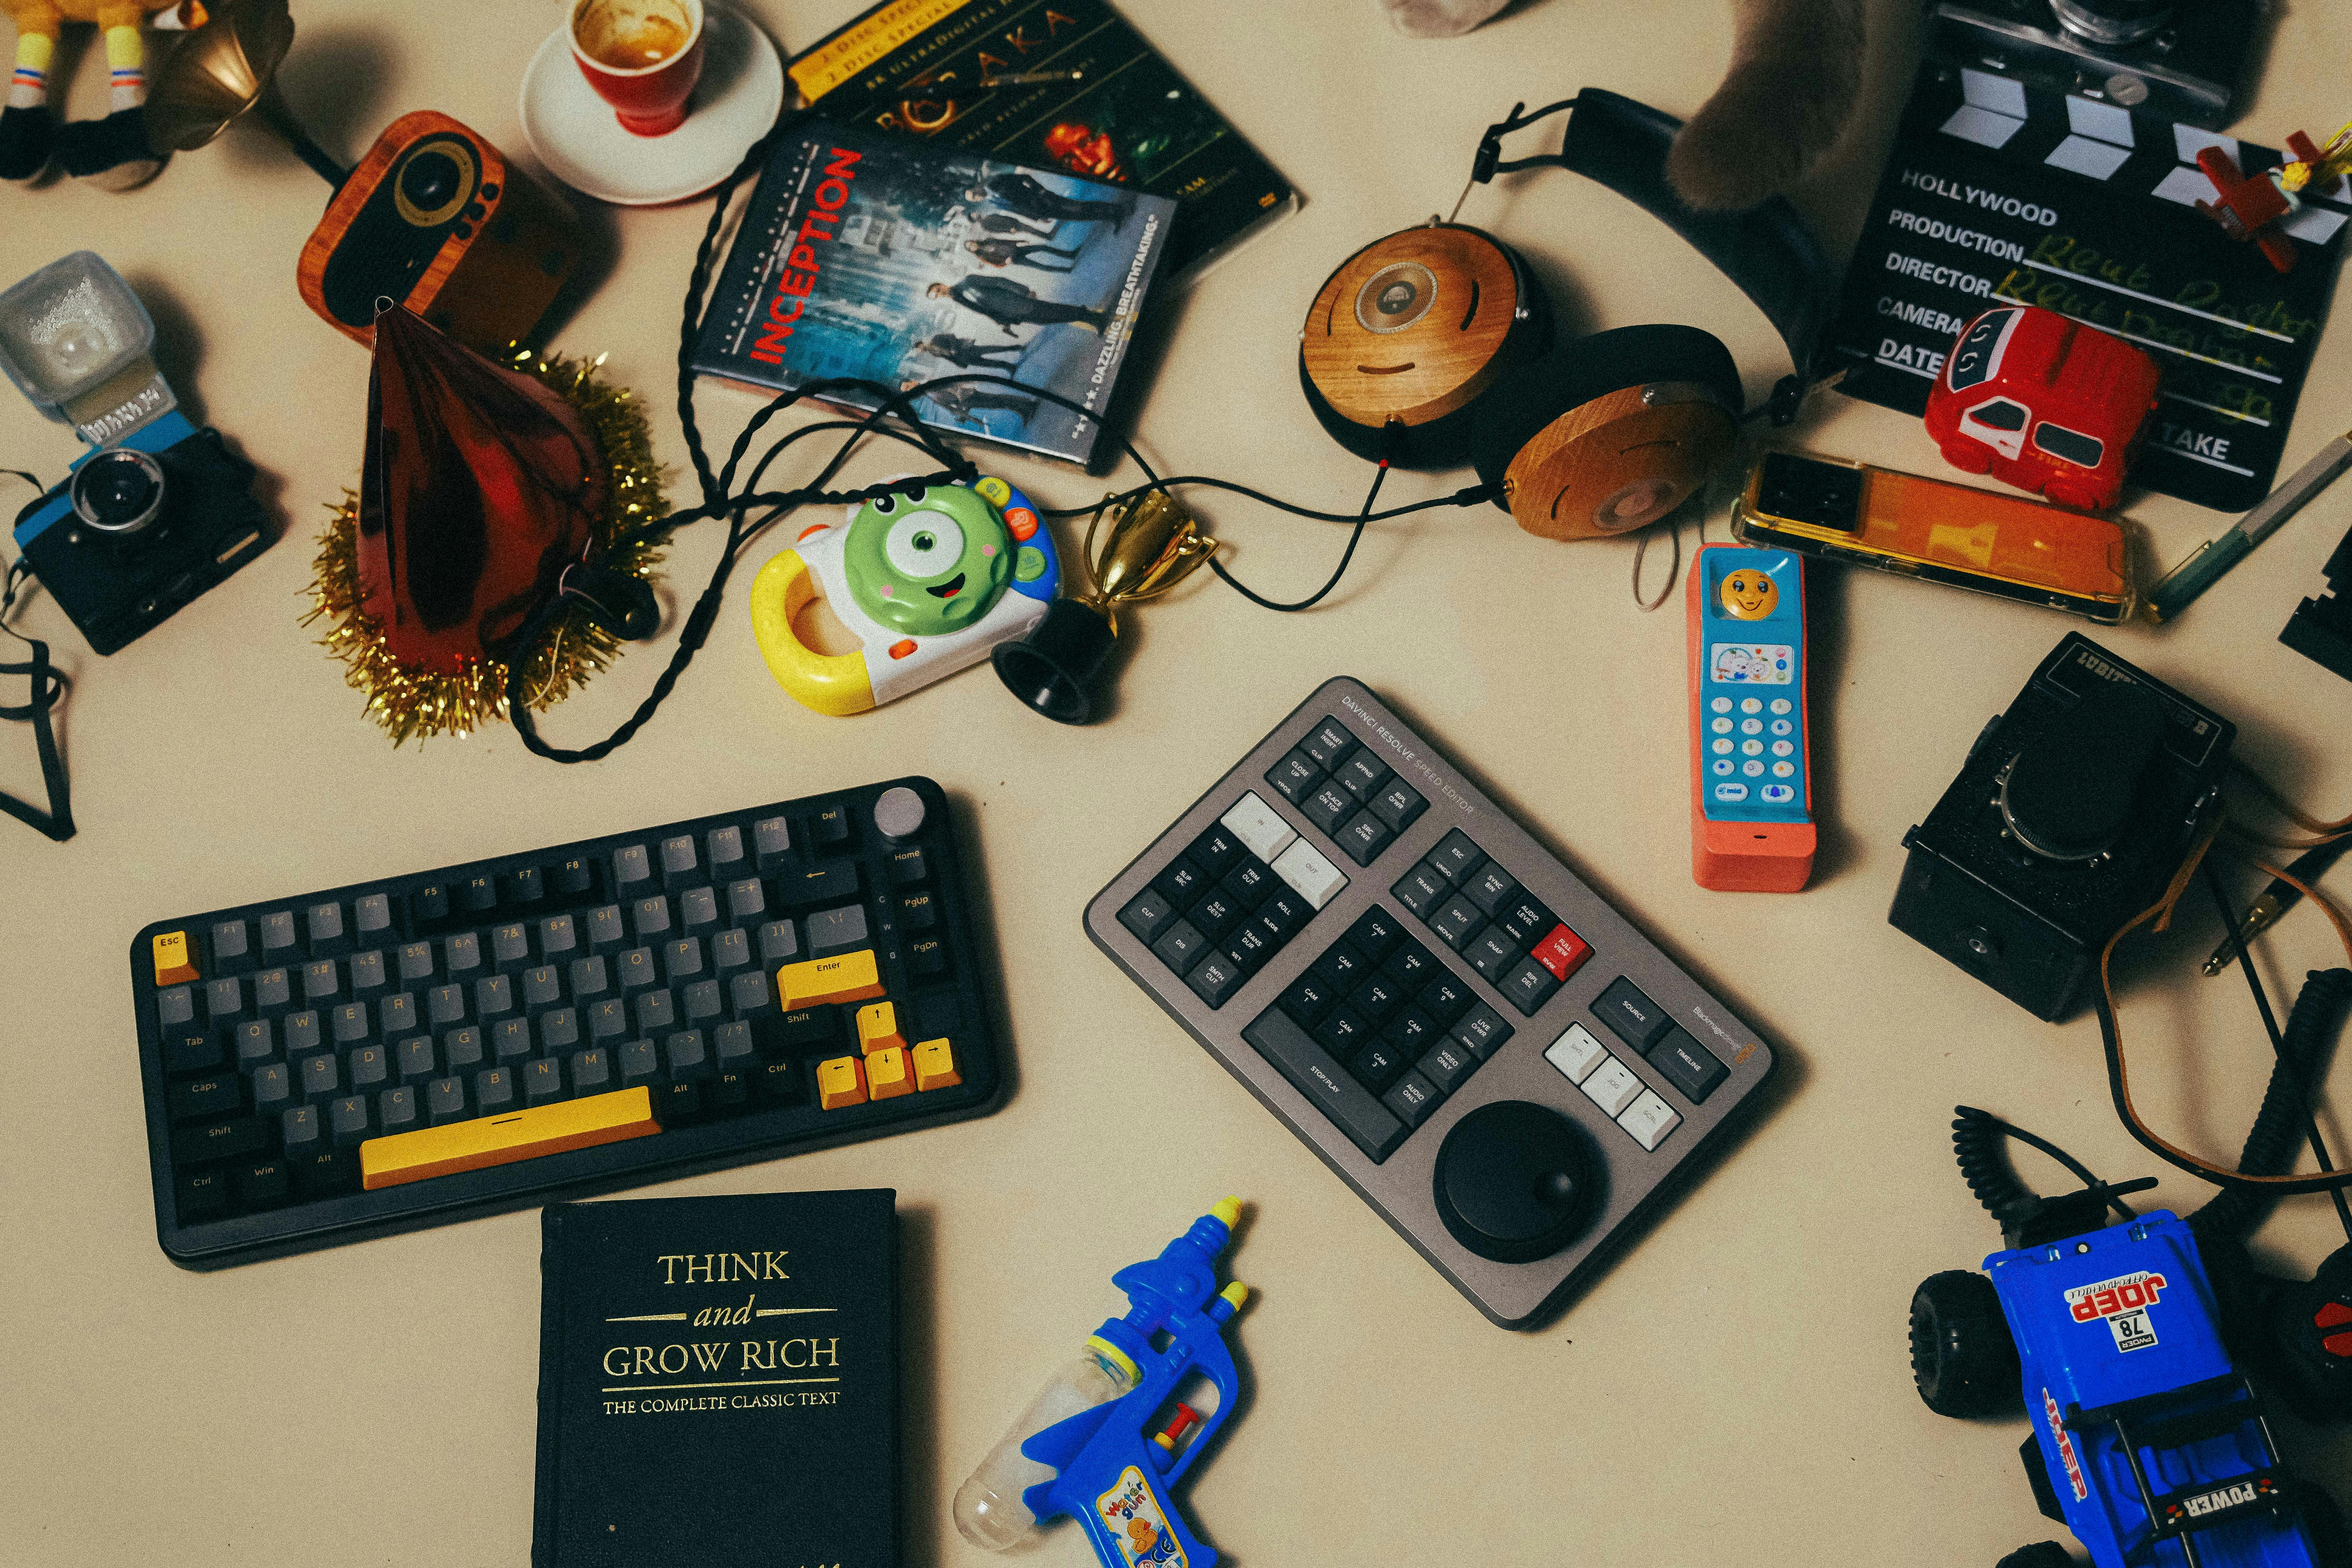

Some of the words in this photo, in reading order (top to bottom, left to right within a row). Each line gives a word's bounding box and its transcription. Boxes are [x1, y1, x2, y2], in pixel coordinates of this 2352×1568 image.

[1901, 168, 2058, 227] HOLLYWOOD
[1888, 210, 2024, 262] PRODUCTION
[750, 148, 862, 364] INCEPTION
[1885, 253, 1993, 298] DIRECTOR
[1876, 298, 1963, 336] CAMERA
[1878, 339, 1945, 374] DATE
[2161, 423, 2230, 460] TAKE
[2077, 651, 2138, 683] LUBIT
[1320, 735, 1337, 748] INSRT
[1325, 729, 1342, 745] SMART
[1312, 750, 1323, 760] CLIP
[1342, 696, 1378, 728] DAVINCI
[1377, 726, 1415, 762] RESOLVE
[1415, 760, 1442, 786] SPEED
[1442, 784, 1474, 815] EDITOR
[1291, 761, 1308, 777] CLOSE
[1355, 762, 1374, 778] APPND
[1278, 781, 1291, 794] YPOS
[1345, 781, 1356, 791] CLIP
[1325, 791, 1342, 807] PLACE
[1389, 795, 1404, 809] O/WR
[1394, 792, 1406, 804] RIPL
[1329, 802, 1339, 812] TOP
[822, 811, 836, 820] Del
[1355, 827, 1370, 841] O/WR
[1362, 824, 1374, 835] SRC
[1214, 838, 1227, 851] TRIM
[895, 850, 920, 861] Home
[1452, 848, 1464, 859] ESC
[566, 861, 579, 870] F8
[1436, 862, 1451, 877] UNDO
[519, 870, 531, 879] F7
[1175, 875, 1187, 886] SRC
[1180, 870, 1191, 881] SLIP
[1242, 874, 1254, 885] OUT
[1246, 868, 1259, 881] TRIM
[1416, 877, 1433, 894] TRANS
[1485, 882, 1495, 892] BIN
[1488, 875, 1503, 889] SYNC
[905, 897, 928, 907] PgUp
[1404, 894, 1417, 907] TITLE
[1142, 908, 1154, 918] CUT
[1207, 905, 1222, 918] DEST
[1213, 902, 1225, 913] SLIP
[1277, 902, 1291, 916] ROLL
[1521, 905, 1539, 921] AUDIO
[1452, 910, 1467, 923] SPLIT
[1517, 910, 1532, 926] LEVEL
[1264, 918, 1278, 932] SLIDE
[1372, 923, 1385, 936] CAM
[1437, 925, 1453, 940] MOVE
[1506, 924, 1522, 939] MARK
[160, 936, 179, 946] ESC
[1175, 939, 1185, 949] DIS
[1242, 937, 1254, 949] DUR
[1245, 930, 1262, 947] TRANS
[1559, 938, 1571, 951] FULL
[680, 944, 688, 954] P
[914, 941, 937, 952] PgDn
[1487, 941, 1502, 954] SNAP
[1231, 951, 1241, 961] SET
[1407, 955, 1420, 968] CAM
[816, 960, 841, 972] Enter
[1339, 956, 1352, 969] CAM
[537, 971, 545, 982] U
[1206, 973, 1218, 983] CUT
[1209, 966, 1224, 981] SMTH
[1526, 972, 1537, 983] RIPL
[489, 981, 499, 991] Y
[1521, 976, 1531, 988] DEL
[443, 990, 450, 1000] T
[1305, 989, 1318, 1001] CAM
[1373, 988, 1386, 1000] CAM
[1442, 987, 1455, 1000] CAM
[347, 1008, 355, 1019] E
[604, 1004, 612, 1014] K
[1623, 1001, 1645, 1022] SOURCE
[296, 1016, 309, 1027] W
[787, 1012, 810, 1023] Shift
[508, 1024, 517, 1034] H
[1340, 1021, 1352, 1033] CAM
[1408, 1020, 1421, 1032] CAM
[1472, 1023, 1487, 1037] O/WR
[1477, 1019, 1490, 1031] LIVE
[185, 1037, 203, 1046] Tab
[413, 1042, 420, 1052] F
[364, 1052, 373, 1062] D
[586, 1054, 596, 1064] M
[1374, 1054, 1387, 1066] CAM
[1441, 1050, 1458, 1066] VIDEO
[1677, 1049, 1701, 1072] TIMELINE
[539, 1063, 548, 1073] N
[769, 1063, 786, 1073] Ctrl
[1437, 1056, 1453, 1071] ONLY
[268, 1070, 276, 1080] A
[492, 1074, 499, 1083] B
[1311, 1066, 1340, 1093] STOP/PLAY
[192, 1082, 217, 1092] Caps
[674, 1084, 688, 1093] Alt
[1406, 1084, 1424, 1101] AUDIO
[1403, 1090, 1419, 1104] ONLY
[208, 1126, 231, 1136] Shift
[318, 1154, 331, 1163] Alt
[254, 1166, 274, 1175] Win
[193, 1177, 211, 1186] Ctrl
[657, 1251, 789, 1284] THINK
[2073, 1276, 2165, 1321] JOEP
[693, 1294, 755, 1326] and
[2120, 1318, 2144, 1337] 78
[603, 1342, 730, 1377] GROW
[741, 1337, 840, 1370] RICH
[603, 1401, 636, 1414] THE
[641, 1396, 726, 1413] COMPLETE
[732, 1393, 794, 1409] CLASSIC
[798, 1392, 841, 1407] TEXT
[2043, 1391, 2086, 1497] JOEP
[2184, 1483, 2257, 1517] POWER
